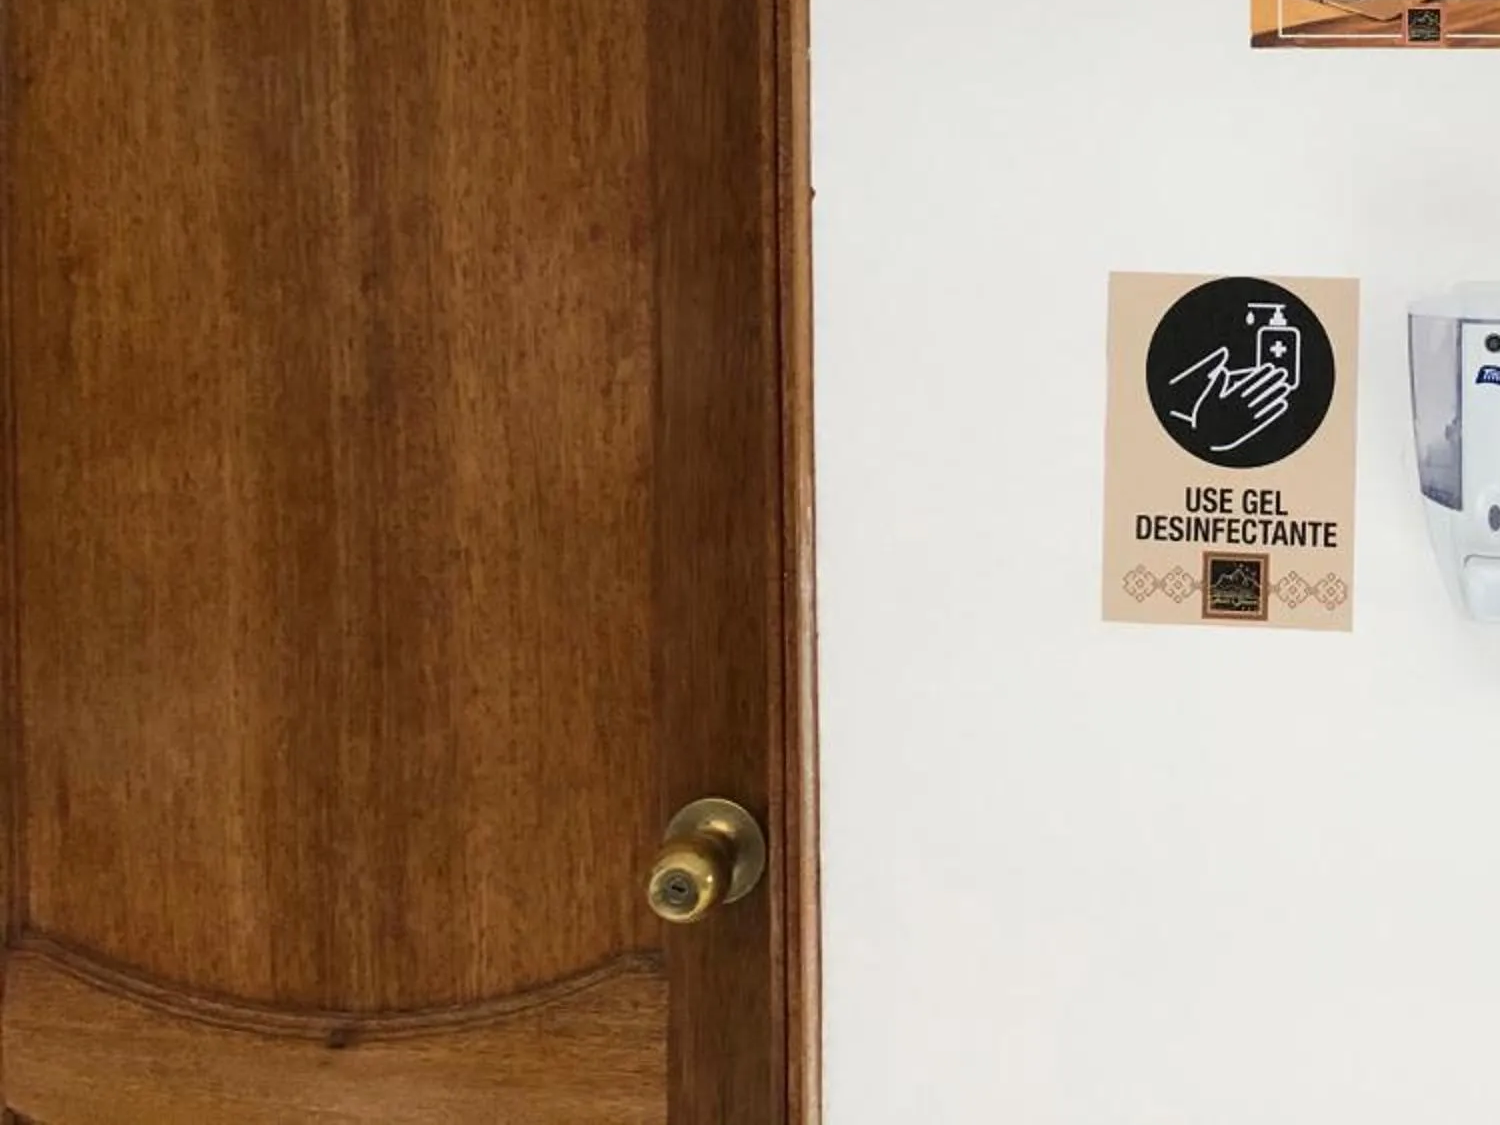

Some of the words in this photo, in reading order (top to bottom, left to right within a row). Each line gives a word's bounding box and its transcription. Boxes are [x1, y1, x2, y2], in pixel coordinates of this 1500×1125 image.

[1185, 487, 1233, 514] USE
[1242, 488, 1289, 516] GEL
[1136, 515, 1338, 548] DESINFECTANTE
